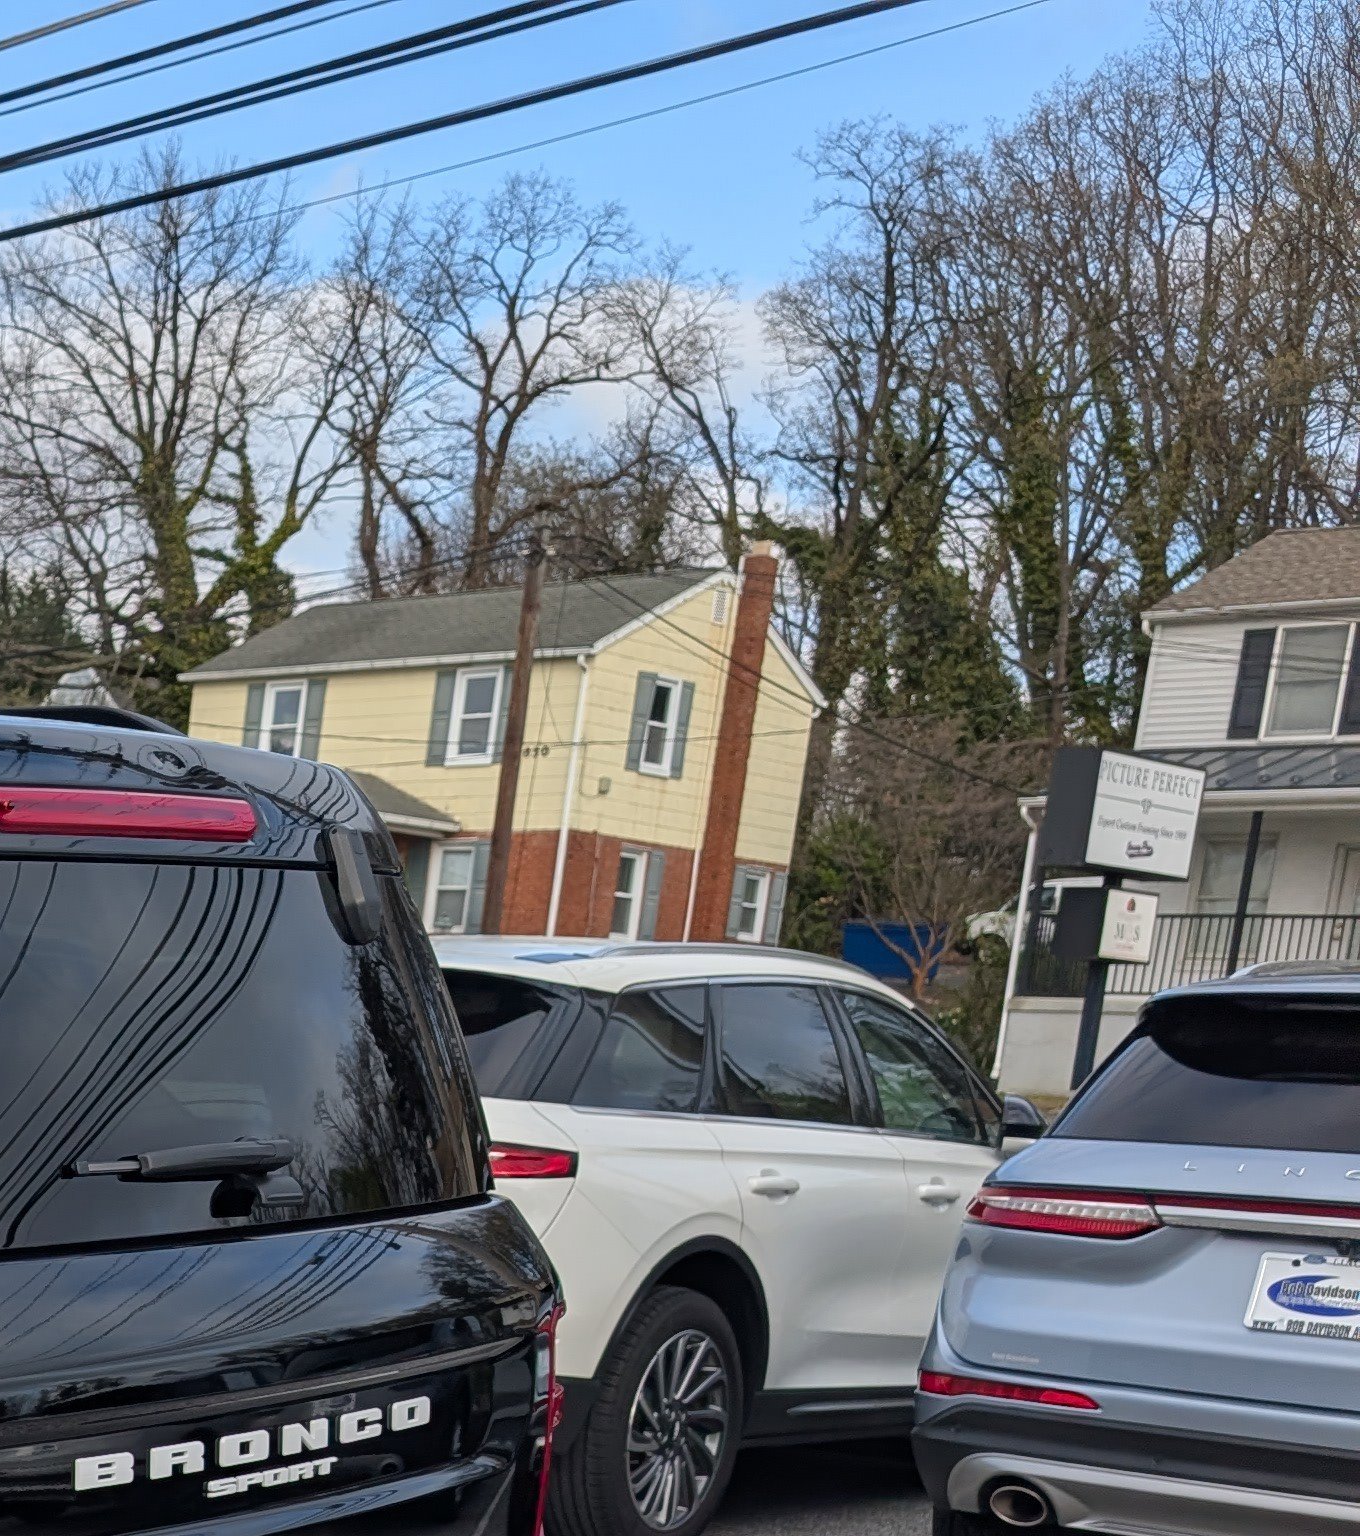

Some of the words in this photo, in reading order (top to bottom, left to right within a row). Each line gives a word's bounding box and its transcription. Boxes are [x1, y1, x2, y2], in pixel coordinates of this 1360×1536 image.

[1100, 760, 1150, 789] PICTURE
[1151, 770, 1200, 799] PERFECT
[73, 1396, 431, 1491] BRONCO
[204, 1457, 338, 1498] SPORT
